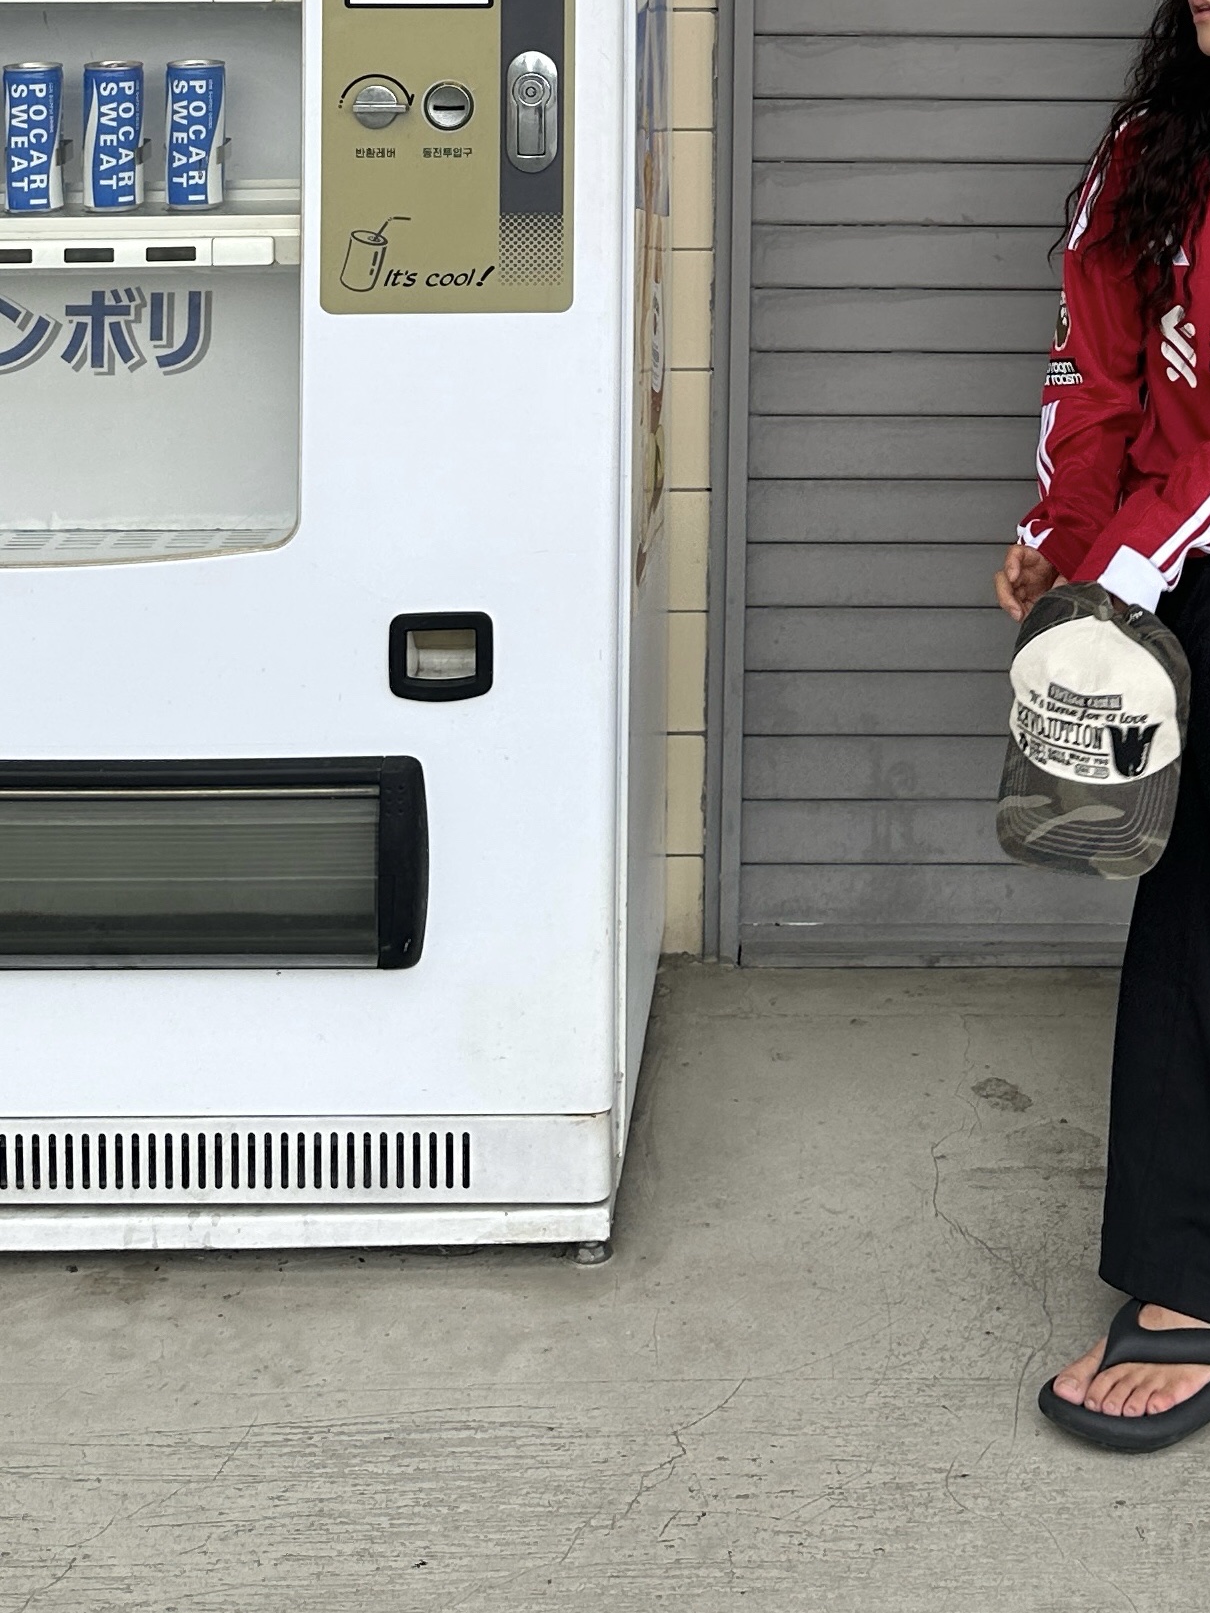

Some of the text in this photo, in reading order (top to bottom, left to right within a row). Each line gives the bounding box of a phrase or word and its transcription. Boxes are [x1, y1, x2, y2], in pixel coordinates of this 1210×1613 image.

[11, 83, 29, 192] SWEAT
[29, 83, 48, 205] POCARI
[100, 82, 118, 190] SWEAT
[118, 80, 135, 203] POCARI
[172, 79, 188, 188] SWEAT
[188, 79, 207, 201] POCARI
[355, 147, 396, 158] 반환레버
[422, 147, 473, 158] 동전투입구
[384, 265, 495, 287] It's cool!
[1077, 708, 1102, 721] for
[1105, 713, 1117, 722] a
